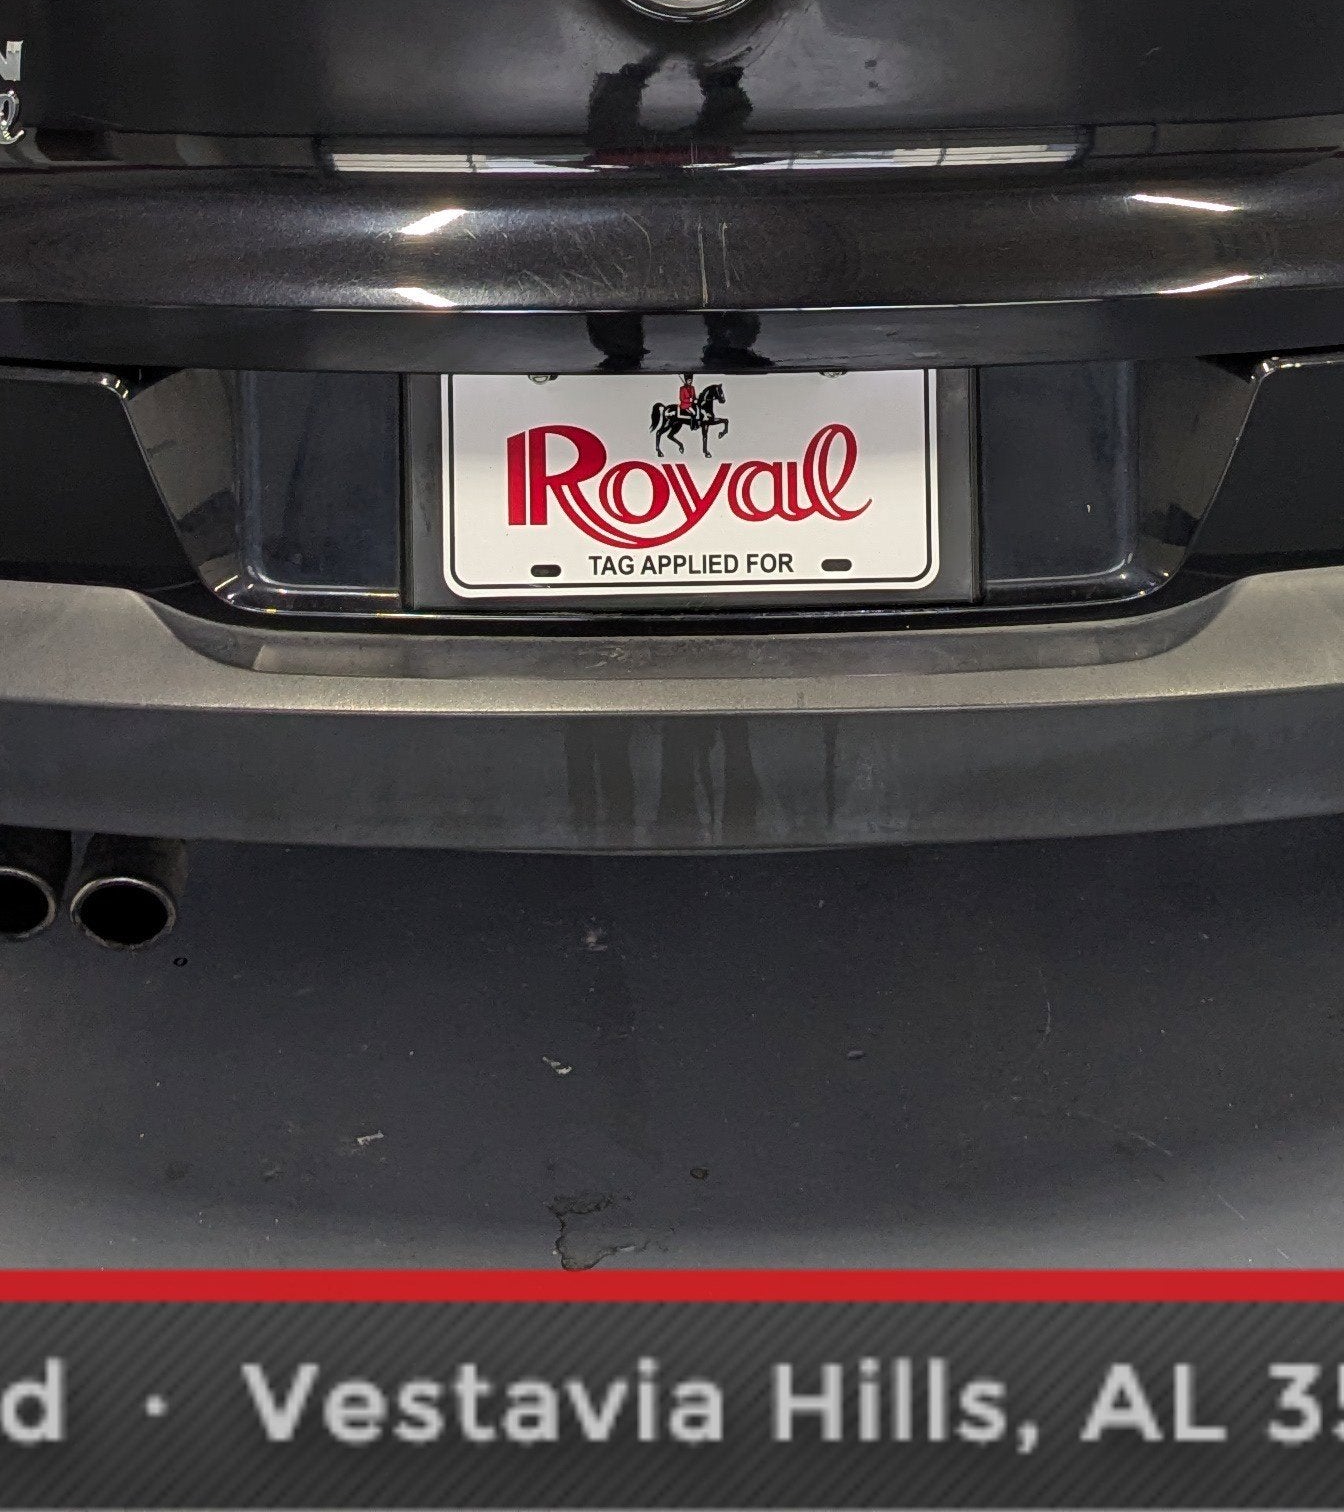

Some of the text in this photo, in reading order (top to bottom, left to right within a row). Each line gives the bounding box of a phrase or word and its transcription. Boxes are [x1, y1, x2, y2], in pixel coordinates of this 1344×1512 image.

[506, 423, 872, 549] Royal
[588, 553, 794, 576] TAG APPLIED FOR
